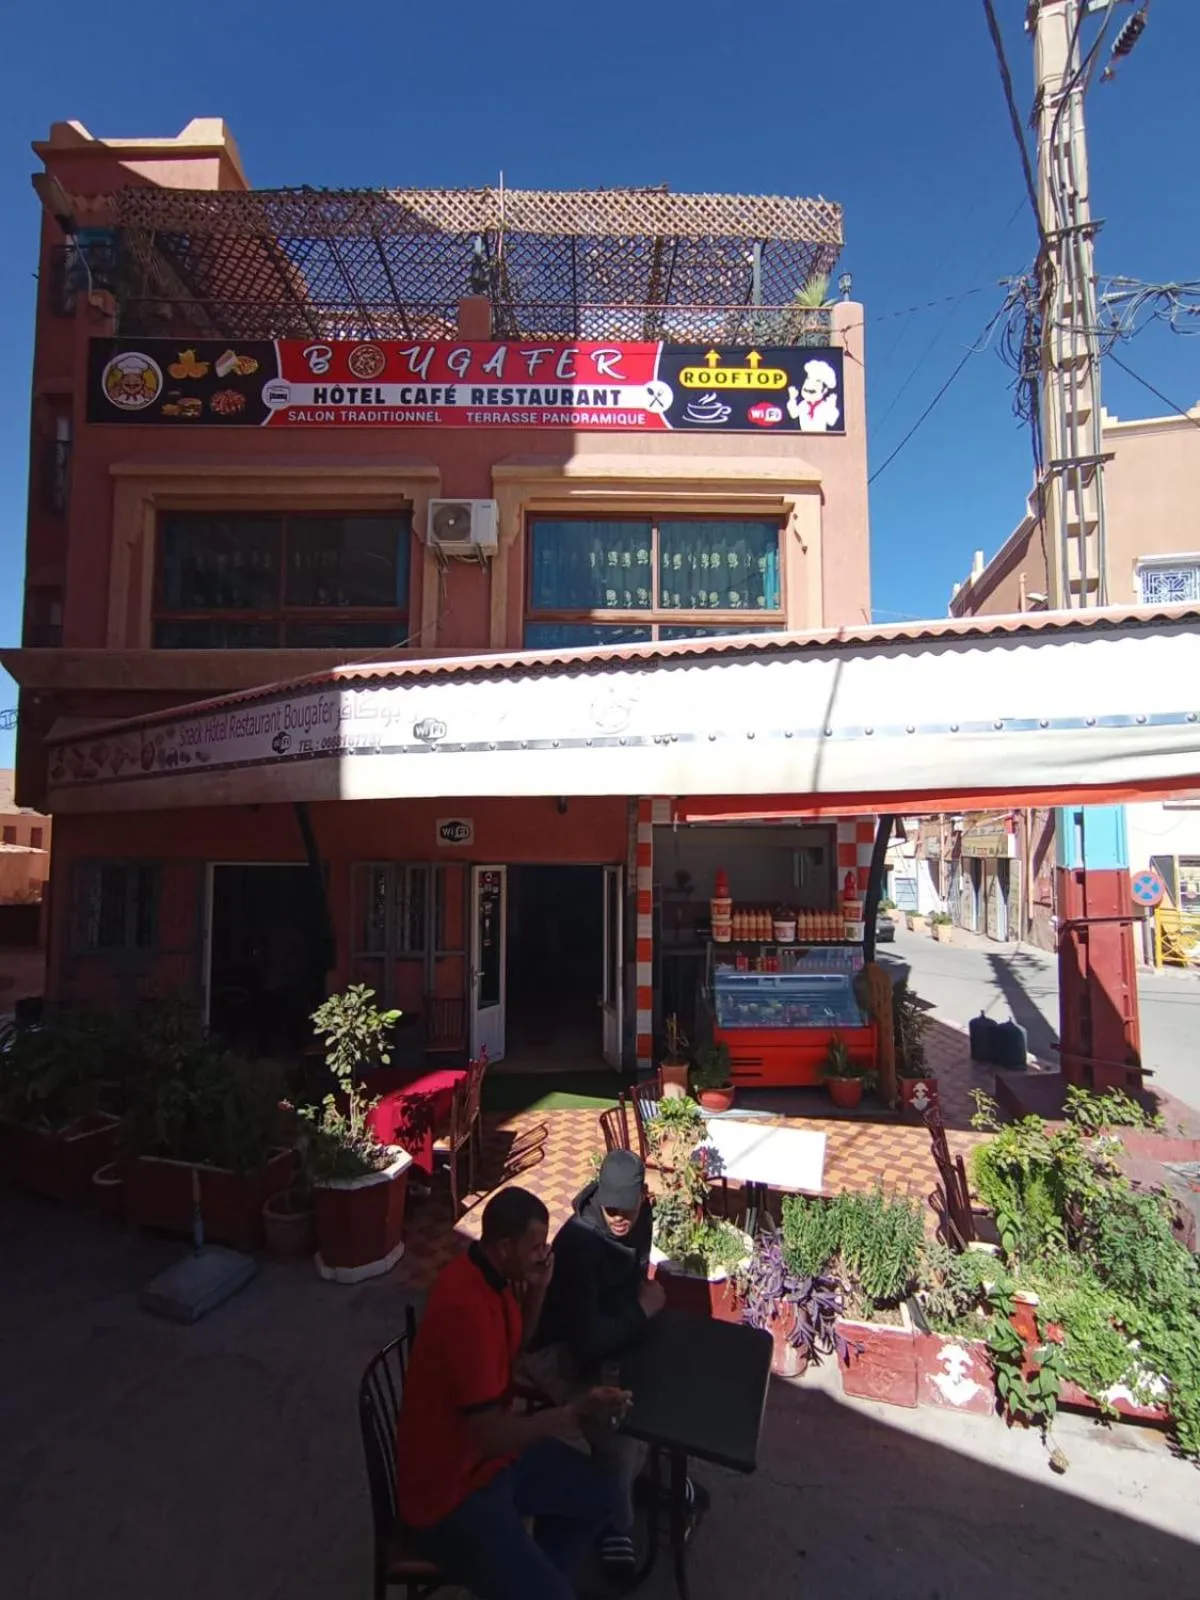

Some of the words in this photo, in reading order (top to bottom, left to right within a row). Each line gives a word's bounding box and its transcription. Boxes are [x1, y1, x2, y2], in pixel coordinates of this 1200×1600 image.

[684, 371, 784, 385] ROOFTOP
[314, 384, 386, 404] HÔTEL
[400, 384, 457, 405] CAFÉ
[471, 388, 621, 406] RESTAURANT
[288, 411, 335, 422] SALON
[341, 411, 442, 422] TRADITIONNEL
[466, 412, 537, 424] TERRASSE
[542, 413, 646, 425] PANORAMIQUE
[229, 709, 281, 738] Restaurant
[284, 696, 335, 733] Bougafer
